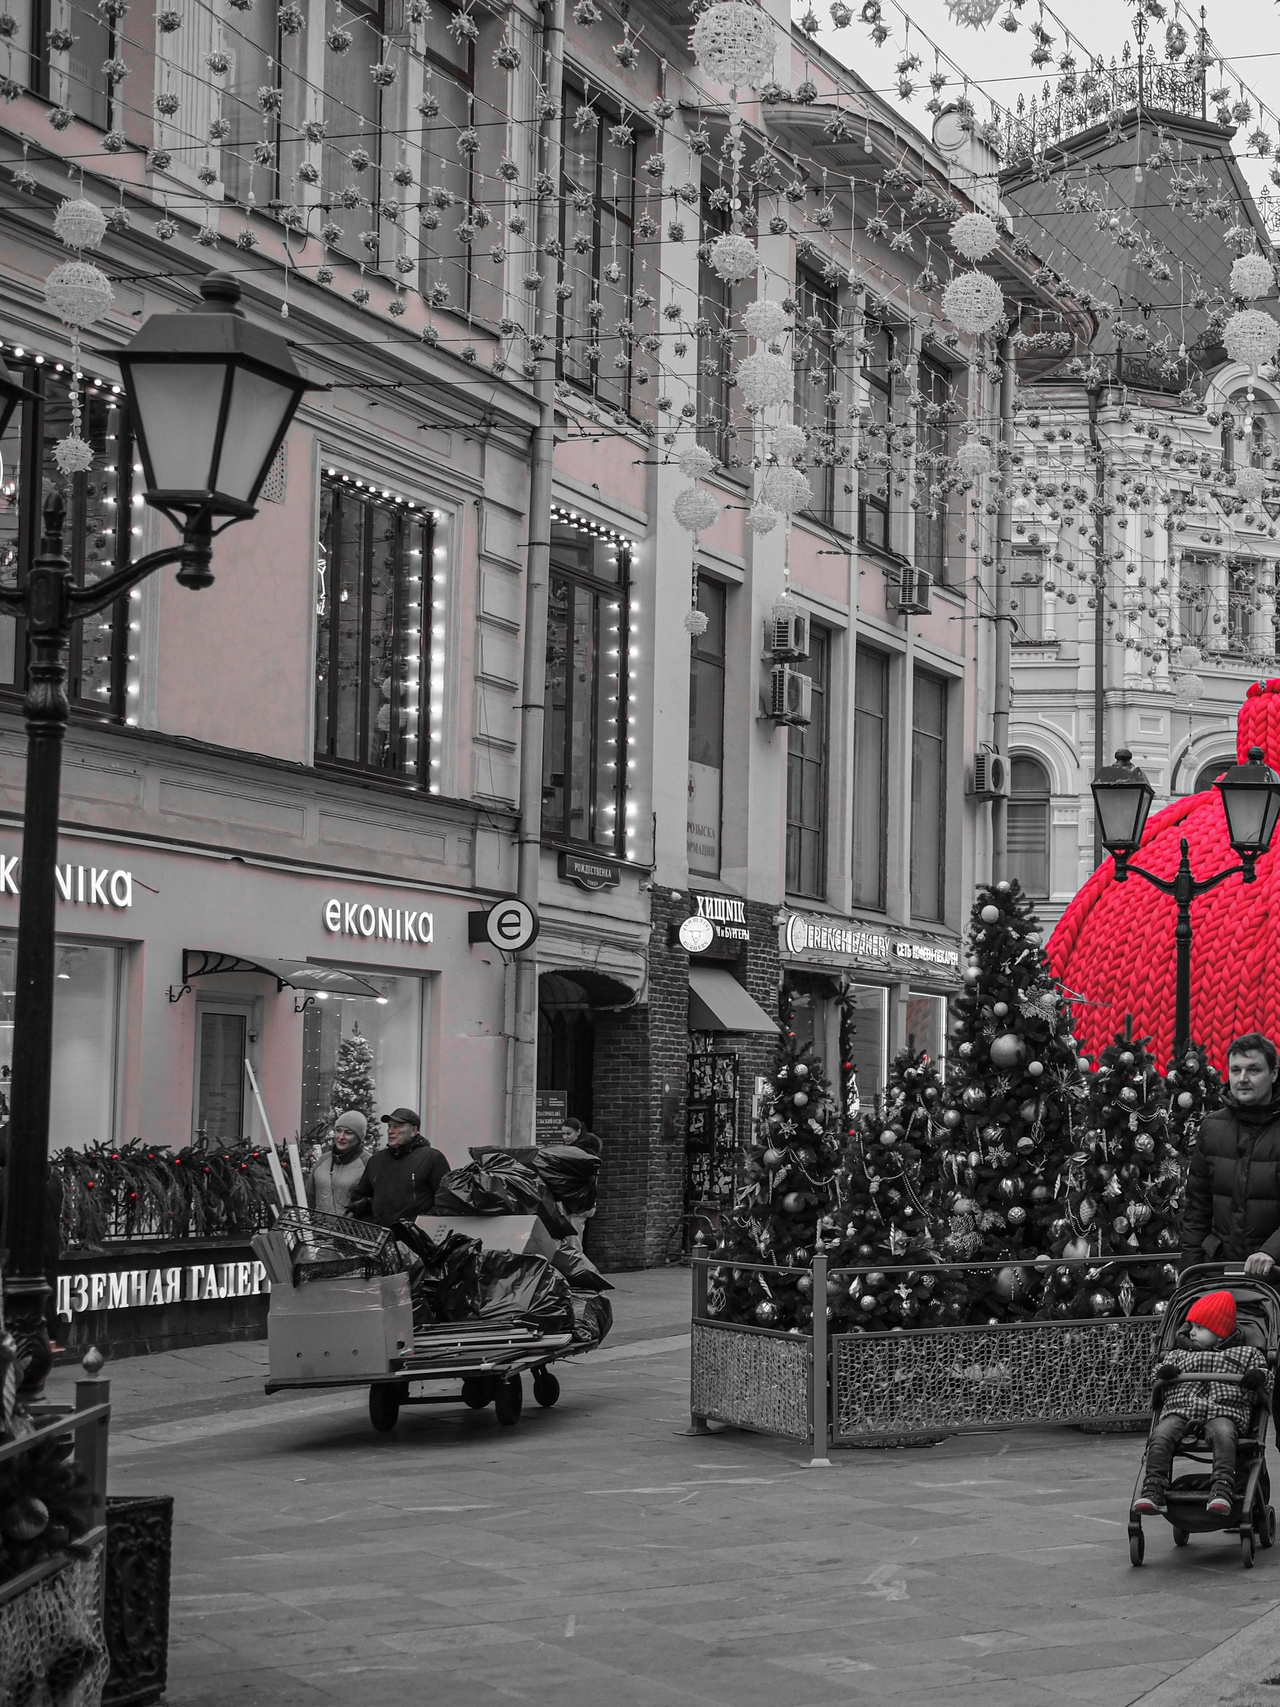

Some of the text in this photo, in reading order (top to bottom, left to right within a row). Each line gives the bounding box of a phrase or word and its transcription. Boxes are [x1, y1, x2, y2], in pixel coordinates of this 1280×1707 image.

[574, 862, 612, 878] РОЖДЕСТВЕНКА
[725, 926, 750, 940] БУРГЕРЫ
[807, 924, 891, 958] FRENCH BAKERY
[187, 1260, 272, 1301] ГАЛЕР
